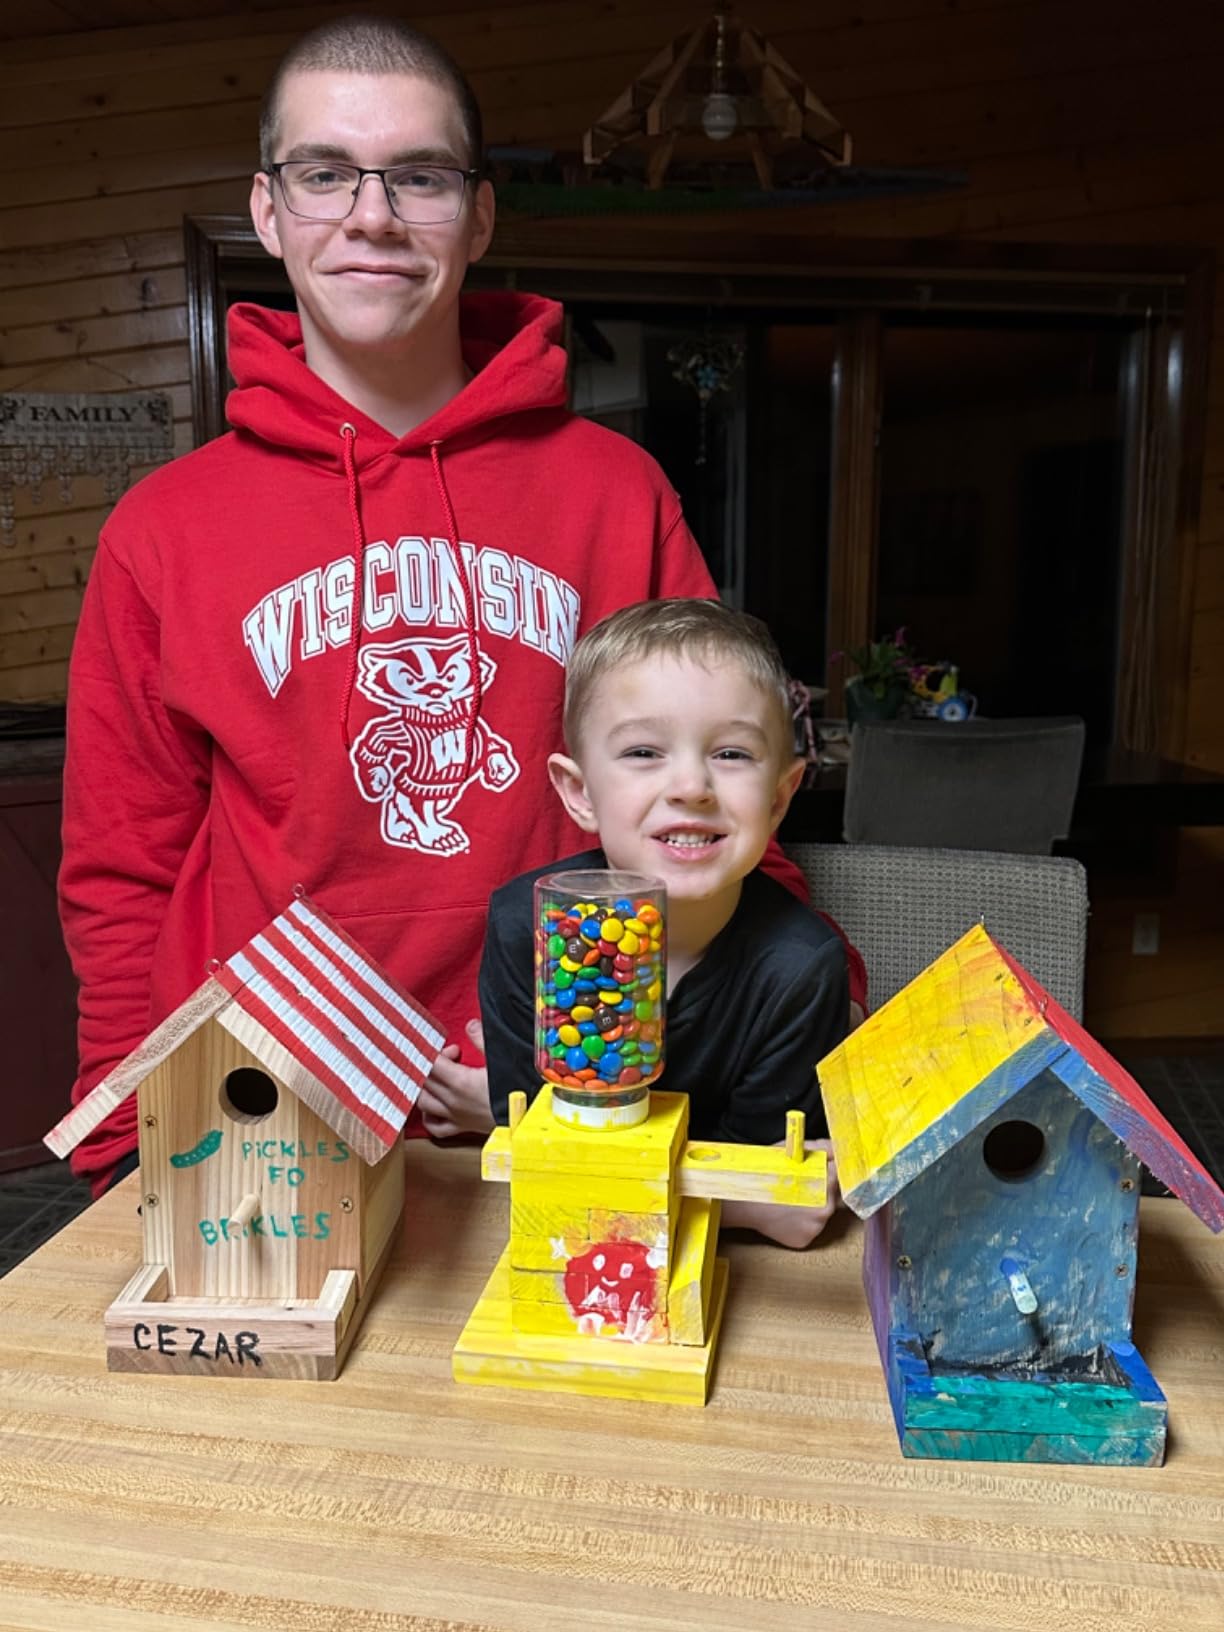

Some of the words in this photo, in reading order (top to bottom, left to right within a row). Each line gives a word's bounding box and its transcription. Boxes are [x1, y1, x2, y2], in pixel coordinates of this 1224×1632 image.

[29, 405, 137, 423] FAMILY
[242, 536, 581, 699] WISCONSIN
[268, 1165, 305, 1187] FO
[133, 1323, 262, 1367] CEZAR
